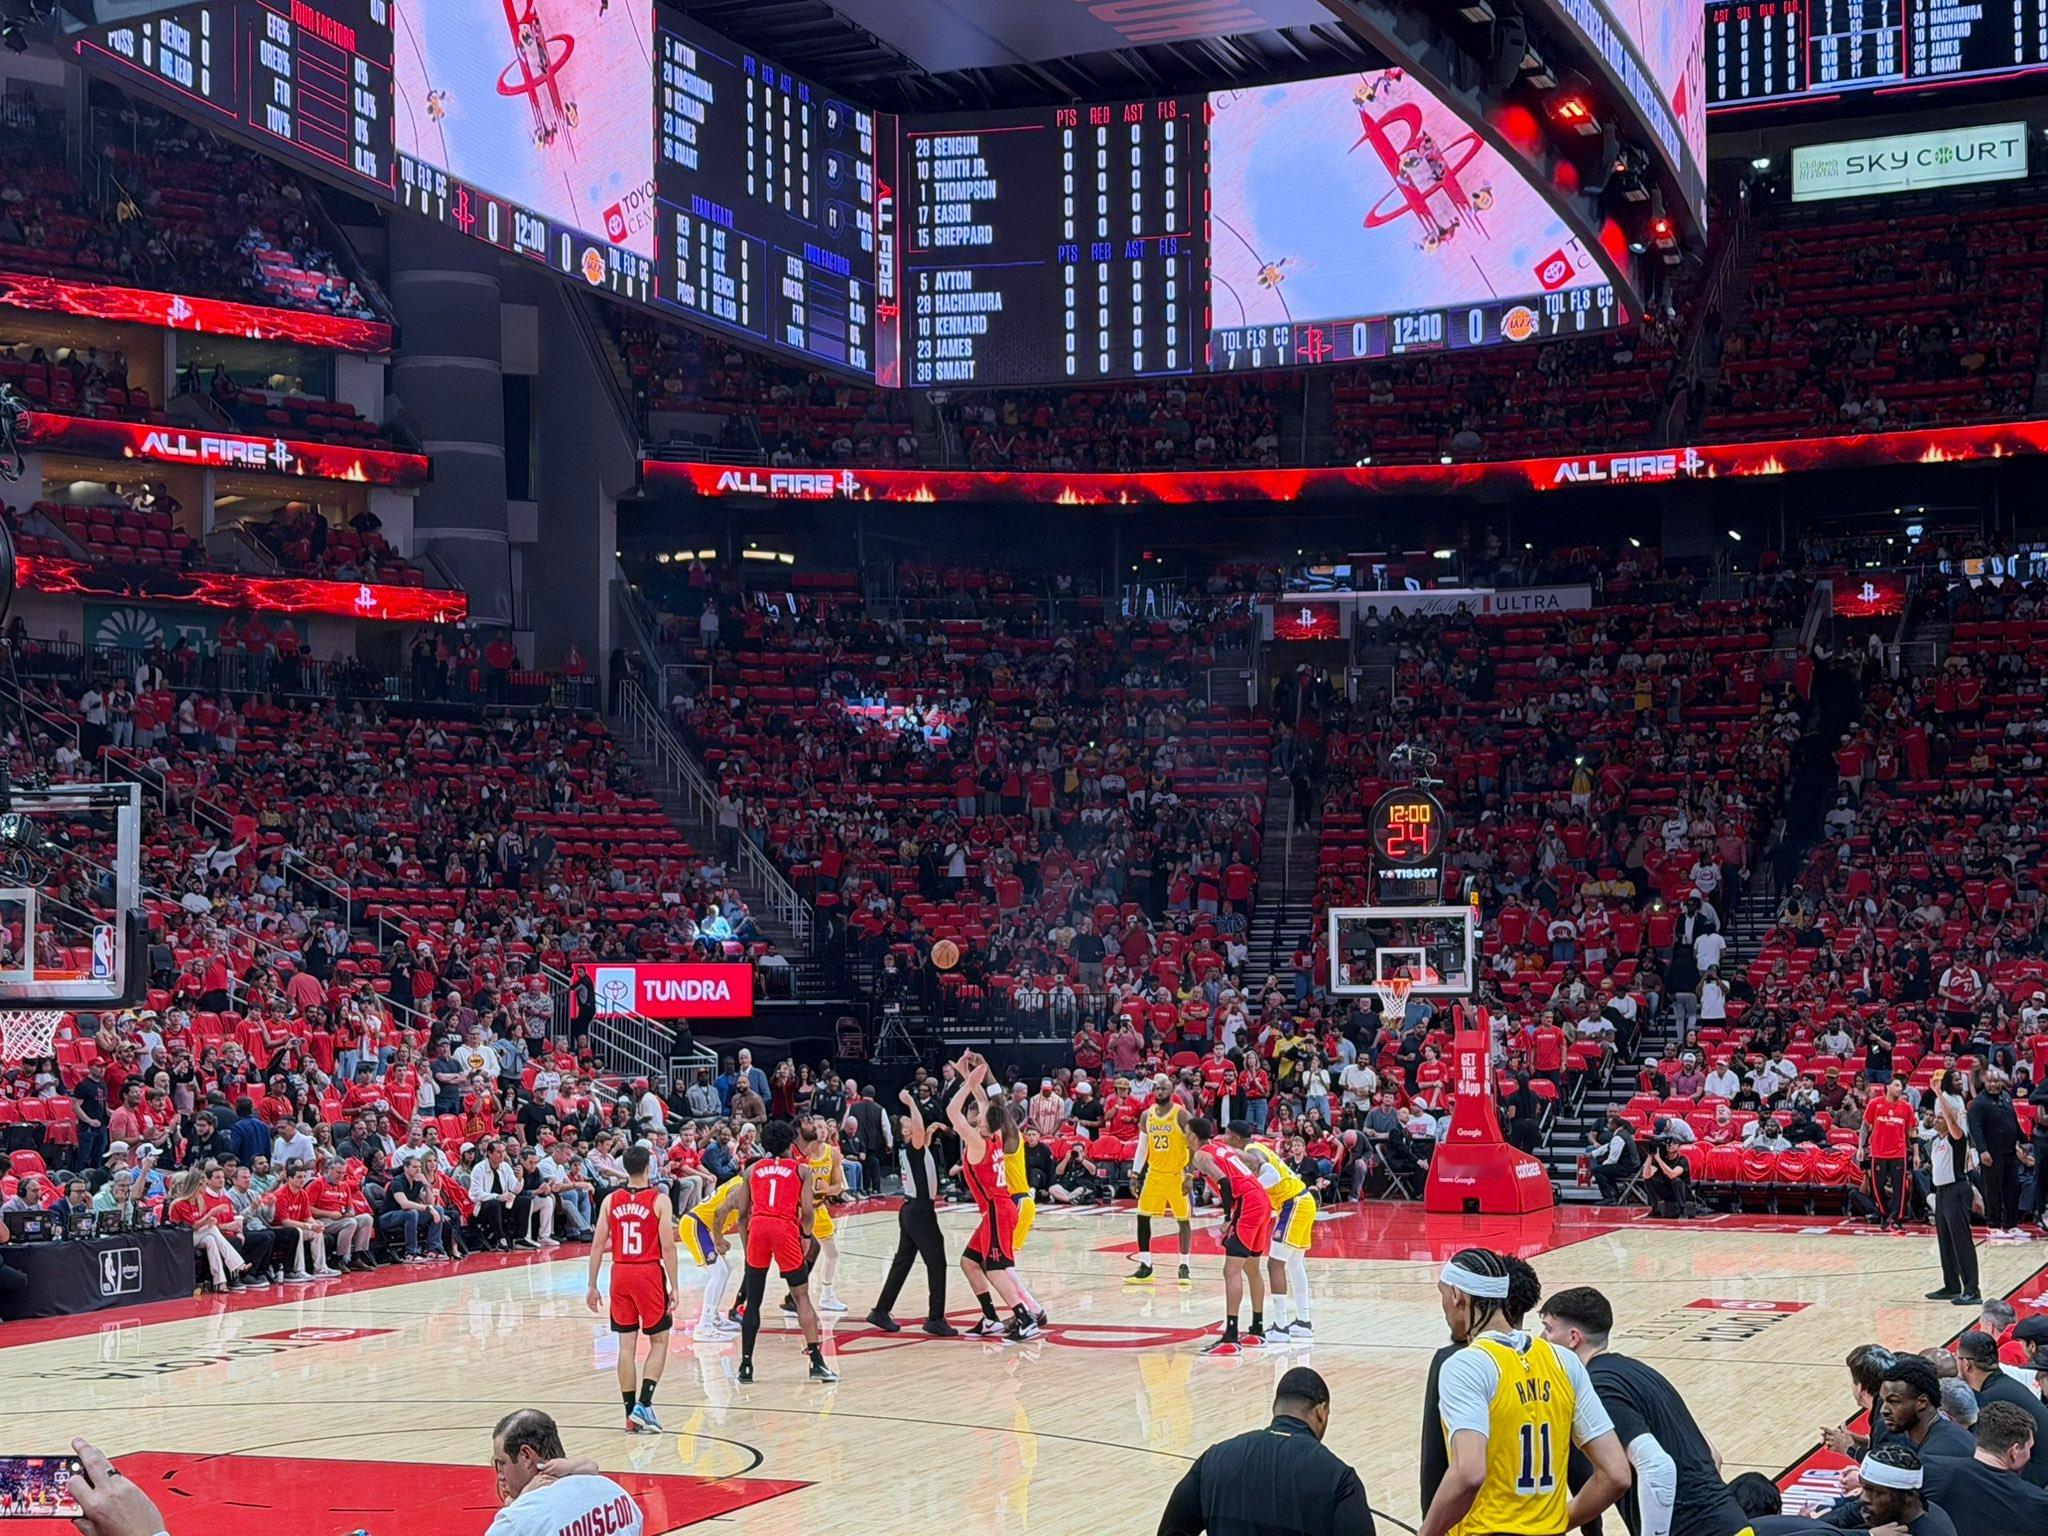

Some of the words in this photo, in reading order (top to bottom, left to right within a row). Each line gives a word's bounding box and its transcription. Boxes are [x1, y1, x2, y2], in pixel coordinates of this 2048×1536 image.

[1930, 4, 1982, 25] HACHIMURA
[160, 19, 190, 57] BENCH
[1914, 28, 1925, 42] 10
[1931, 22, 1970, 41] KENNARD
[1914, 44, 1926, 59] 23
[1931, 40, 1960, 57] JAMES
[1931, 55, 1962, 74] SMART
[1056, 109, 1077, 128] PTS
[1090, 106, 1110, 124] REB
[1124, 104, 1144, 122] AST
[1158, 100, 1176, 120] FLS
[674, 116, 696, 145] JAMES
[916, 138, 930, 158] 28
[934, 136, 978, 156] SENGUN
[1064, 130, 1072, 148] 0
[1098, 127, 1106, 146] 0
[1132, 125, 1140, 144] 0
[1166, 121, 1173, 140] 0
[675, 141, 698, 171] SMART
[917, 161, 929, 180] 10
[934, 159, 970, 179] SMITH
[972, 158, 988, 177] JR.
[1064, 153, 1072, 171] 0
[1098, 150, 1106, 168] 0
[1132, 147, 1140, 166] 0
[1166, 144, 1174, 163] 0
[1846, 150, 1908, 175] SKY
[400, 157, 416, 182] TOL
[418, 164, 432, 192] FLS
[436, 173, 447, 199] CC
[920, 183, 926, 202] 1
[934, 180, 996, 201] THOMPSON
[1065, 175, 1073, 194] 0
[1098, 172, 1106, 191] 0
[1132, 170, 1140, 189] 0
[1166, 167, 1174, 186] 0
[405, 184, 411, 207] 7
[422, 191, 428, 214] 0
[438, 198, 443, 222] 1
[918, 206, 928, 224] 17
[934, 204, 972, 224] EASON
[1065, 198, 1073, 216] 0
[1098, 195, 1106, 214] 0
[1132, 193, 1140, 211] 0
[1166, 190, 1174, 209] 0
[488, 201, 498, 243] 0
[515, 212, 545, 253] 12:00
[562, 233, 571, 272] 0
[918, 228, 930, 247] 15
[934, 225, 993, 246] SHEPPARD
[1065, 220, 1073, 239] 0
[1099, 218, 1107, 237] 0
[1132, 215, 1140, 234] 0
[1166, 213, 1174, 231] 0
[1058, 245, 1078, 264] PTS
[1092, 242, 1112, 261] REB
[1125, 240, 1146, 258] AST
[1159, 237, 1177, 256] FLS
[608, 246, 622, 272] TOL
[624, 253, 636, 278] FLS
[640, 260, 649, 283] CC
[612, 271, 618, 291] 7
[626, 276, 632, 298] 0
[642, 282, 646, 302] 1
[920, 273, 928, 292] 5
[935, 271, 972, 291] AYTON
[917, 295, 931, 314] 28
[935, 292, 1002, 314] HACHIMURA
[1545, 294, 1566, 316] TOL
[1570, 292, 1590, 314] FLS
[1598, 286, 1613, 308] CC
[918, 318, 930, 336] 10
[936, 315, 987, 336] KENNARD
[1352, 322, 1367, 357] 0
[1393, 313, 1442, 344] 12:00
[1469, 308, 1482, 345] 0
[1551, 314, 1558, 334] 7
[1576, 311, 1585, 331] 0
[1602, 308, 1608, 328] 1
[918, 340, 932, 358] 23
[936, 338, 972, 358] JAMES
[1221, 332, 1242, 351] TOL
[1246, 329, 1266, 349] FLS
[1273, 326, 1288, 346] CC
[918, 362, 932, 381] 36
[936, 360, 976, 380] SMART
[1228, 350, 1236, 370] 7
[1252, 348, 1261, 368] 0
[1278, 346, 1284, 366] 1
[140, 432, 197, 458] ALL
[200, 437, 267, 464] FIRE
[1554, 460, 1607, 484] ALL
[1610, 455, 1676, 480] FIRE
[716, 471, 768, 493] ALL
[770, 474, 834, 494] FIRE
[1496, 594, 1560, 611] ULTRA
[1390, 805, 1430, 823] 12:00
[1387, 823, 1428, 855] 24
[1395, 868, 1438, 880] TISSOT
[642, 980, 730, 1001] TUNDRA
[1460, 1053, 1476, 1066] GET
[1462, 1066, 1476, 1080] THE
[1466, 1082, 1480, 1096] App
[1153, 1135, 1169, 1150] 23
[1457, 1128, 1482, 1138] Google
[768, 1178, 776, 1207] 1
[1454, 1176, 1476, 1186] Google
[612, 1202, 650, 1220] SHEPPARD
[620, 1222, 642, 1255] 15
[1516, 1421, 1554, 1495] 11
